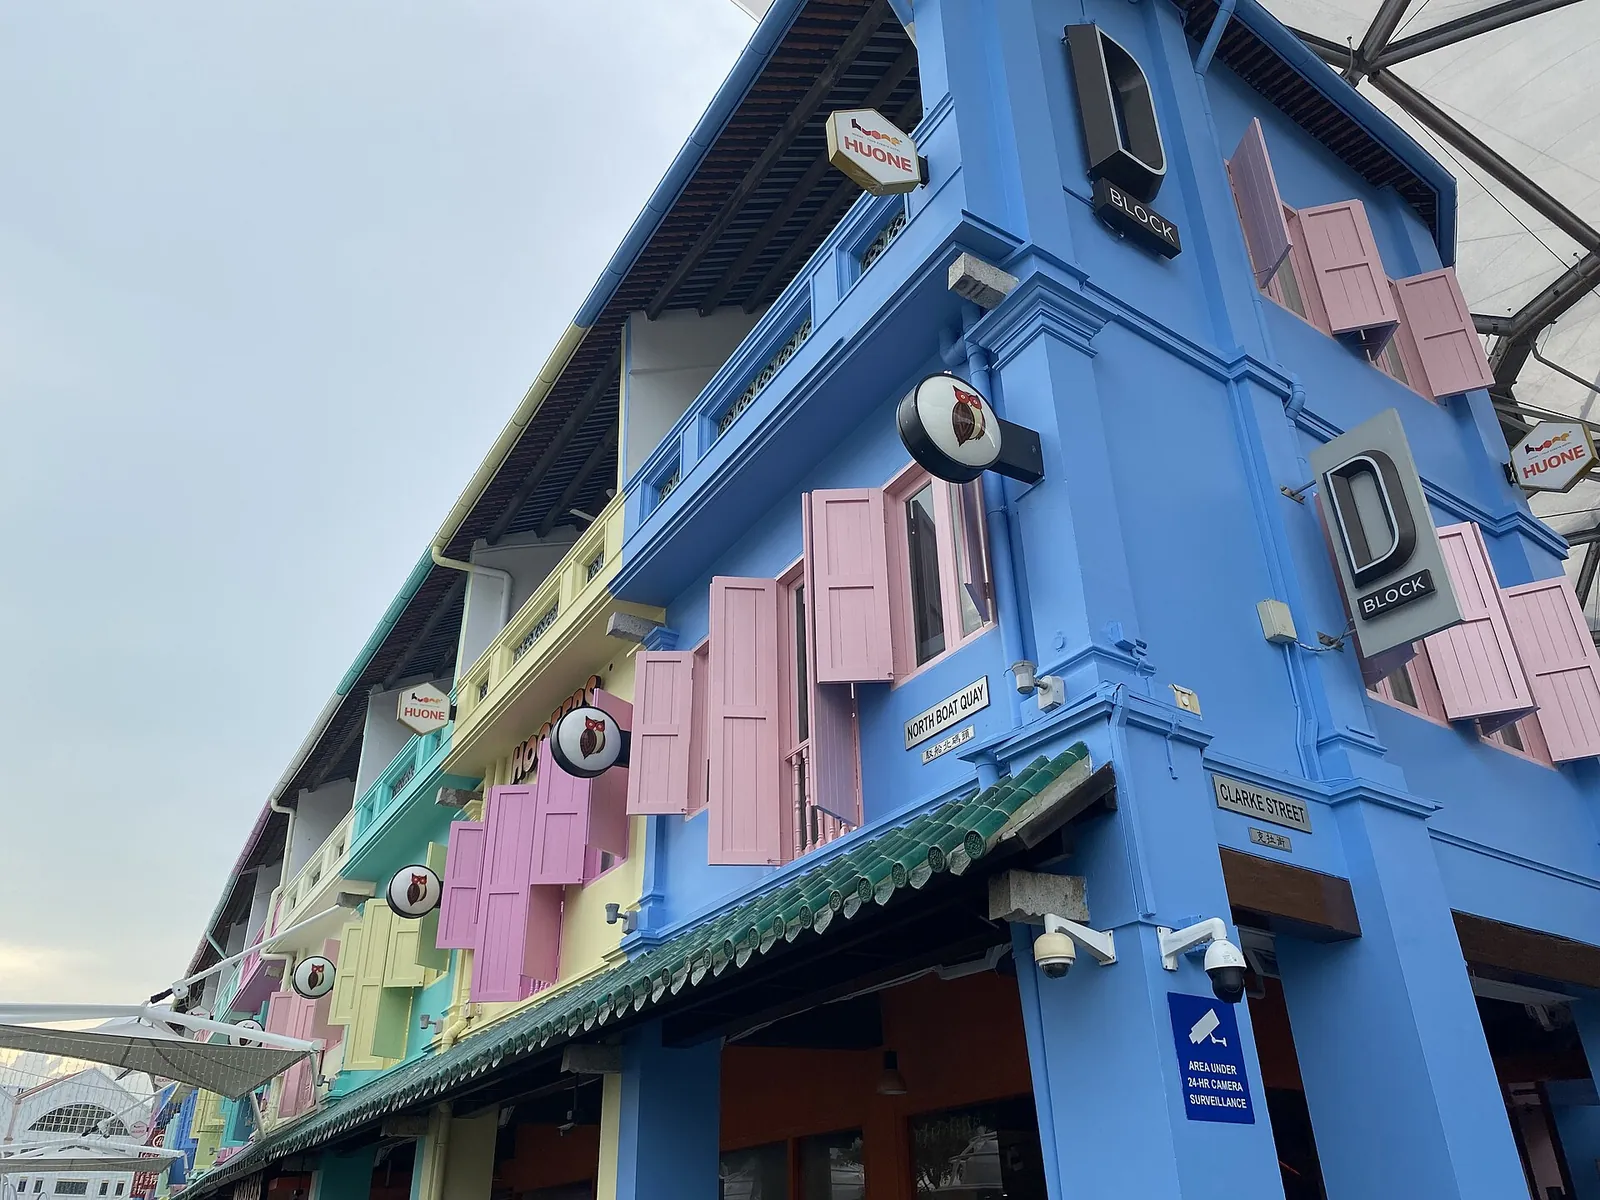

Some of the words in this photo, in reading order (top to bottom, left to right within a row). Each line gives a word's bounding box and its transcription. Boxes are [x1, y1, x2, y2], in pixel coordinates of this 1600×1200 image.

[1066, 24, 1167, 203] D
[844, 136, 913, 173] HUONE
[1109, 187, 1175, 242] BLOCK
[1522, 445, 1586, 479] HUONE
[1322, 450, 1418, 588] D
[1363, 576, 1426, 613] BLOCK
[404, 707, 445, 720] HUONE
[907, 713, 935, 741] NORTH
[936, 699, 958, 726] BOAT
[960, 684, 984, 710] QUAY
[1219, 783, 1265, 811] CLARKE
[1265, 797, 1305, 823] STREET
[1187, 1077, 1210, 1089] 24-HR
[1211, 1079, 1244, 1092] CAMERA
[1189, 1060, 1210, 1072] AREA
[1210, 1063, 1237, 1075] UNDER
[1189, 1094, 1247, 1109] SURVEILLANCE
